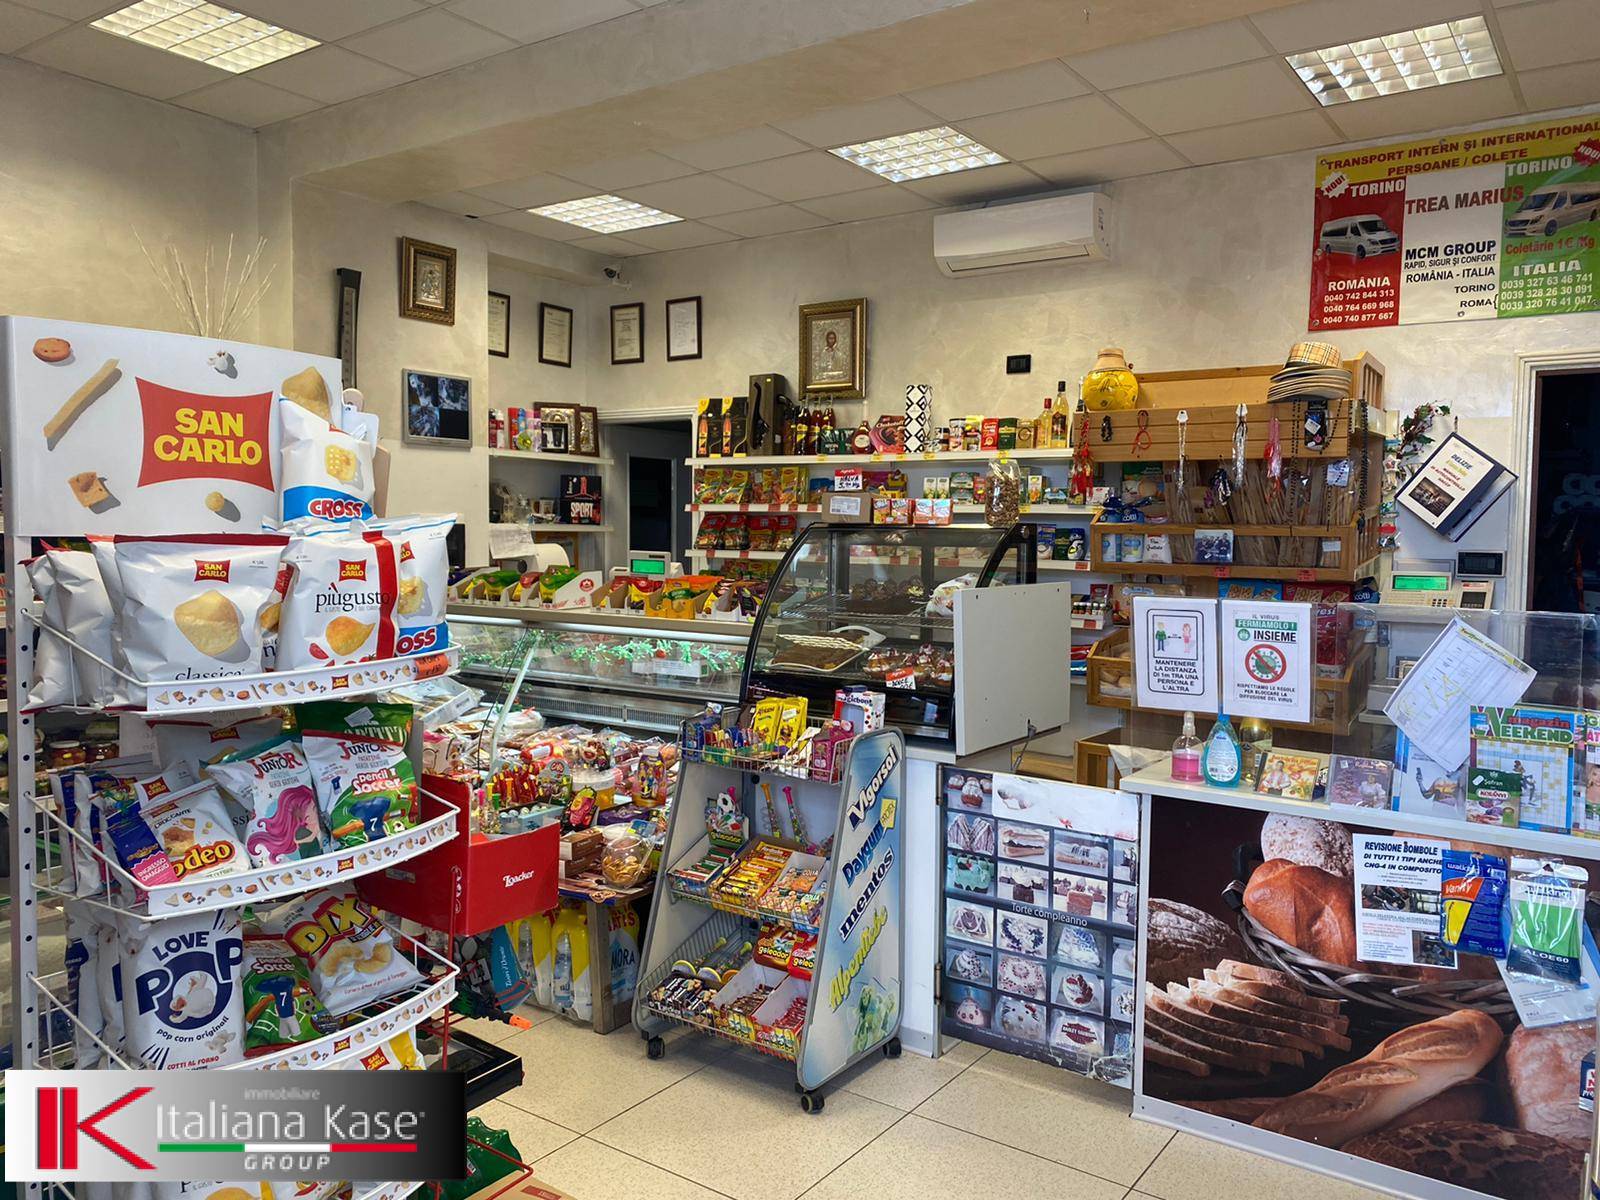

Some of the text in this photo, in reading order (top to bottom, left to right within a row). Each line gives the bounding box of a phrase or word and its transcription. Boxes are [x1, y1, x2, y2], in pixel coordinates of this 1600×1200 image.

[1327, 151, 1404, 170] TRANSPORT
[1408, 142, 1459, 158] INTERN
[1388, 157, 1460, 176] PERSOANE
[1471, 148, 1529, 165] COLETE
[1505, 156, 1572, 178] TORINO
[1351, 179, 1405, 198] TORINO
[1406, 186, 1524, 215] TREA MARIUS
[1405, 240, 1496, 260] MCM GROUP
[1430, 258, 1451, 269] SIGUR
[1461, 254, 1497, 266] CONFORT
[1513, 259, 1581, 277] ITALIA
[1406, 271, 1454, 283] ROMÂNIA
[1463, 266, 1496, 279] ITALIA
[1502, 272, 1593, 289] 0039 327 63 46 741
[1328, 276, 1391, 292] ROMÂNIA
[1454, 283, 1495, 294] TORINO
[1346, 292, 1361, 301] 742
[1460, 298, 1493, 309] ROMA
[1500, 301, 1523, 311] 0039
[1526, 299, 1543, 309] 320
[1560, 296, 1571, 306] 41
[1501, 291, 1523, 301] 0039
[174, 408, 244, 437] SAN
[153, 434, 263, 466] CARLO
[307, 497, 363, 521] CROSS
[204, 564, 223, 573] SAN
[341, 570, 365, 578] CARLO
[345, 564, 361, 572] SAN
[1238, 619, 1289, 630] FERMIAMOLO
[396, 628, 437, 655] OSS
[1253, 630, 1297, 642] INSIEME
[1155, 659, 1196, 667] MANTENERE
[1164, 666, 1197, 674] DISTANZA
[1157, 678, 1189, 686] PERSONA
[246, 751, 303, 780] JUNIOR
[352, 775, 402, 796] Soccer
[846, 743, 897, 832] Vigorsol
[841, 818, 885, 888] Daygum
[1364, 841, 1438, 855] REVISIONE BOMBOLE
[173, 843, 233, 879] odeo
[1401, 855, 1417, 863] TIPI
[502, 870, 535, 888] Loacker
[1397, 865, 1443, 876] COMPOSITO
[840, 848, 893, 940] mentos
[1010, 903, 1088, 927] Torte compleanno
[152, 930, 210, 962] LOVE
[135, 938, 243, 1031] POP
[156, 1016, 230, 1043] pop corn originali
